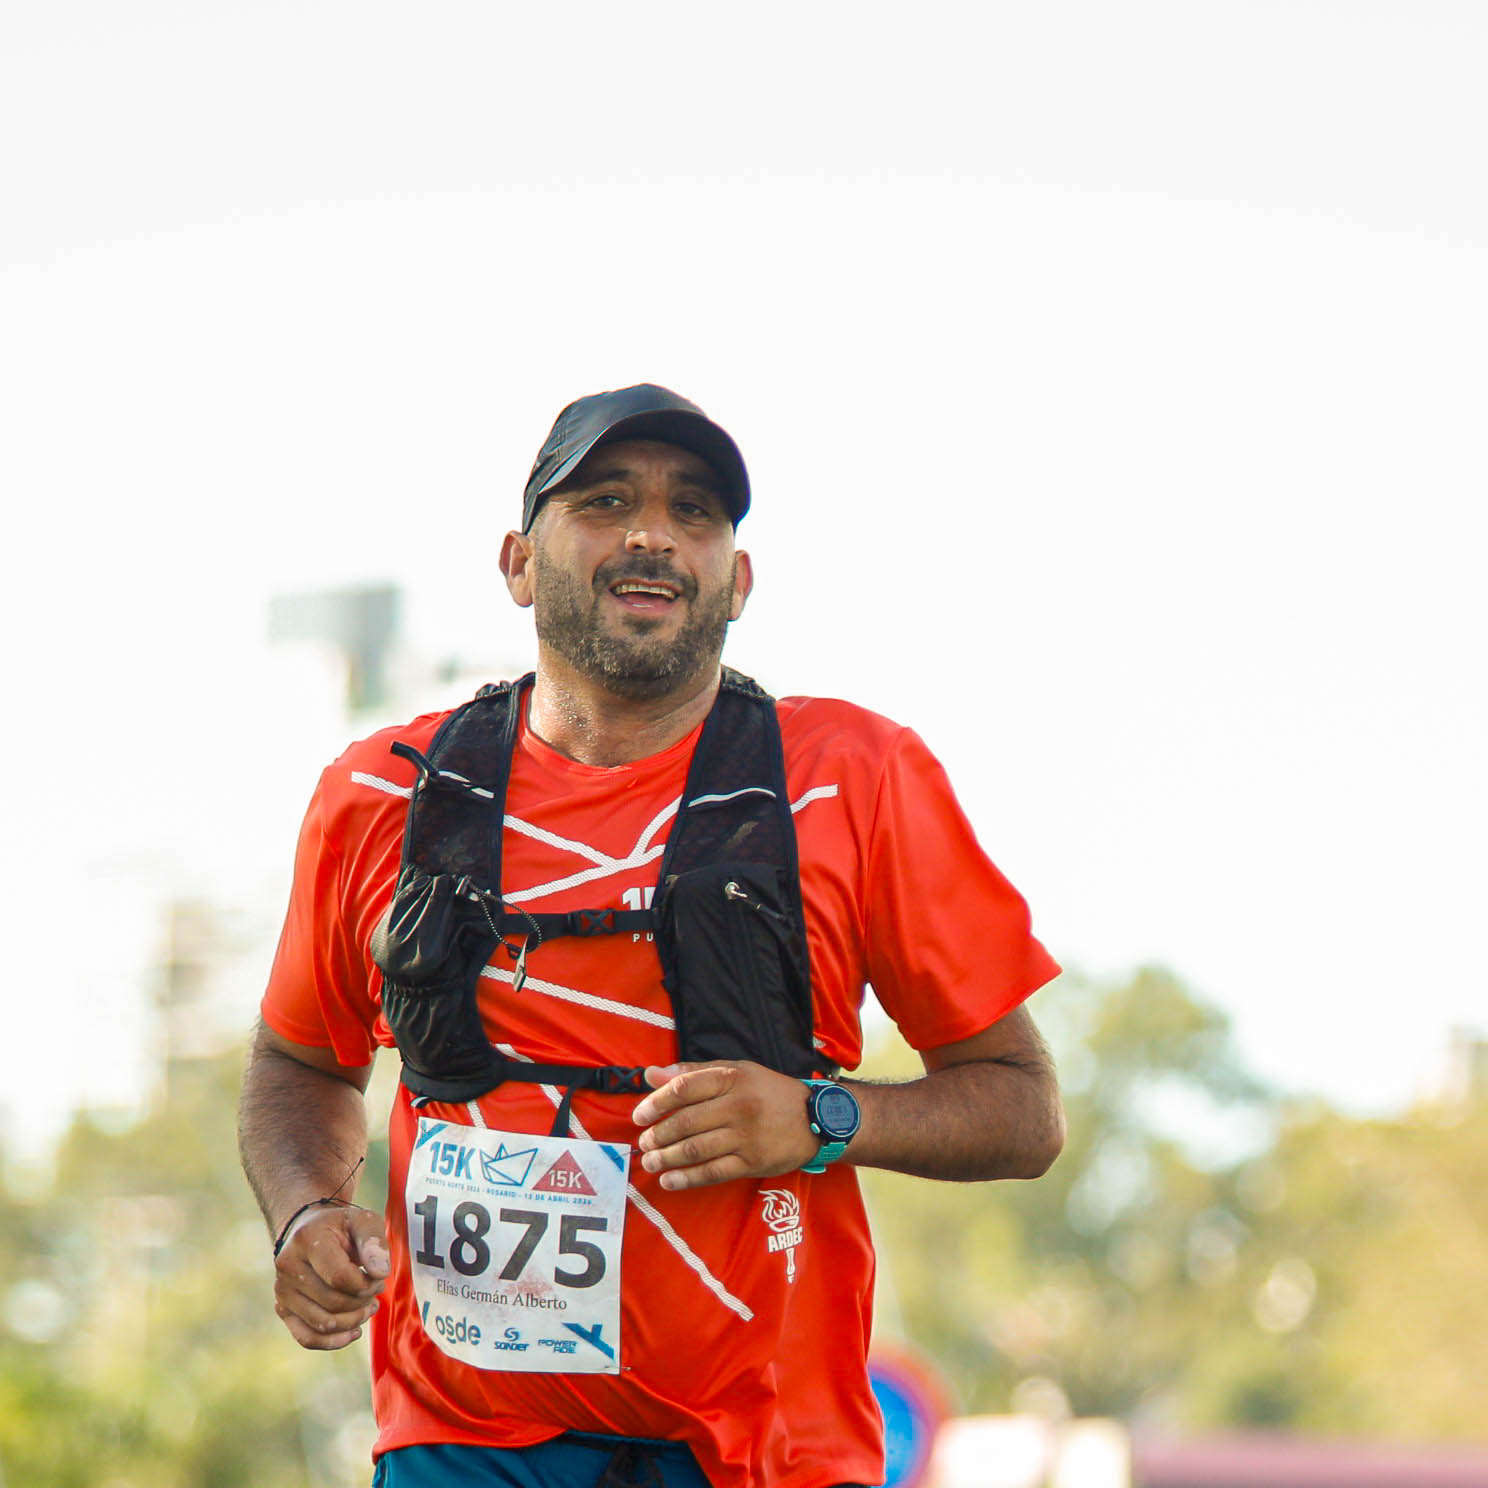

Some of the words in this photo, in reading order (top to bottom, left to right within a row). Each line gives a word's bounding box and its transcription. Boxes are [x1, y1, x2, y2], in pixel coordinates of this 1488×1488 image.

[429, 1141, 476, 1180] 15K
[548, 1170, 582, 1189] 15K
[487, 1187, 516, 1198] ROSARIO
[535, 1193, 545, 1201] DE
[548, 1195, 570, 1204] ABRIL
[414, 1195, 608, 1289] 1875
[768, 1226, 803, 1253] ARDEC
[437, 1278, 459, 1297] Elías
[462, 1284, 508, 1305] Germán
[512, 1293, 568, 1310] Alberto
[435, 1315, 482, 1346] osde
